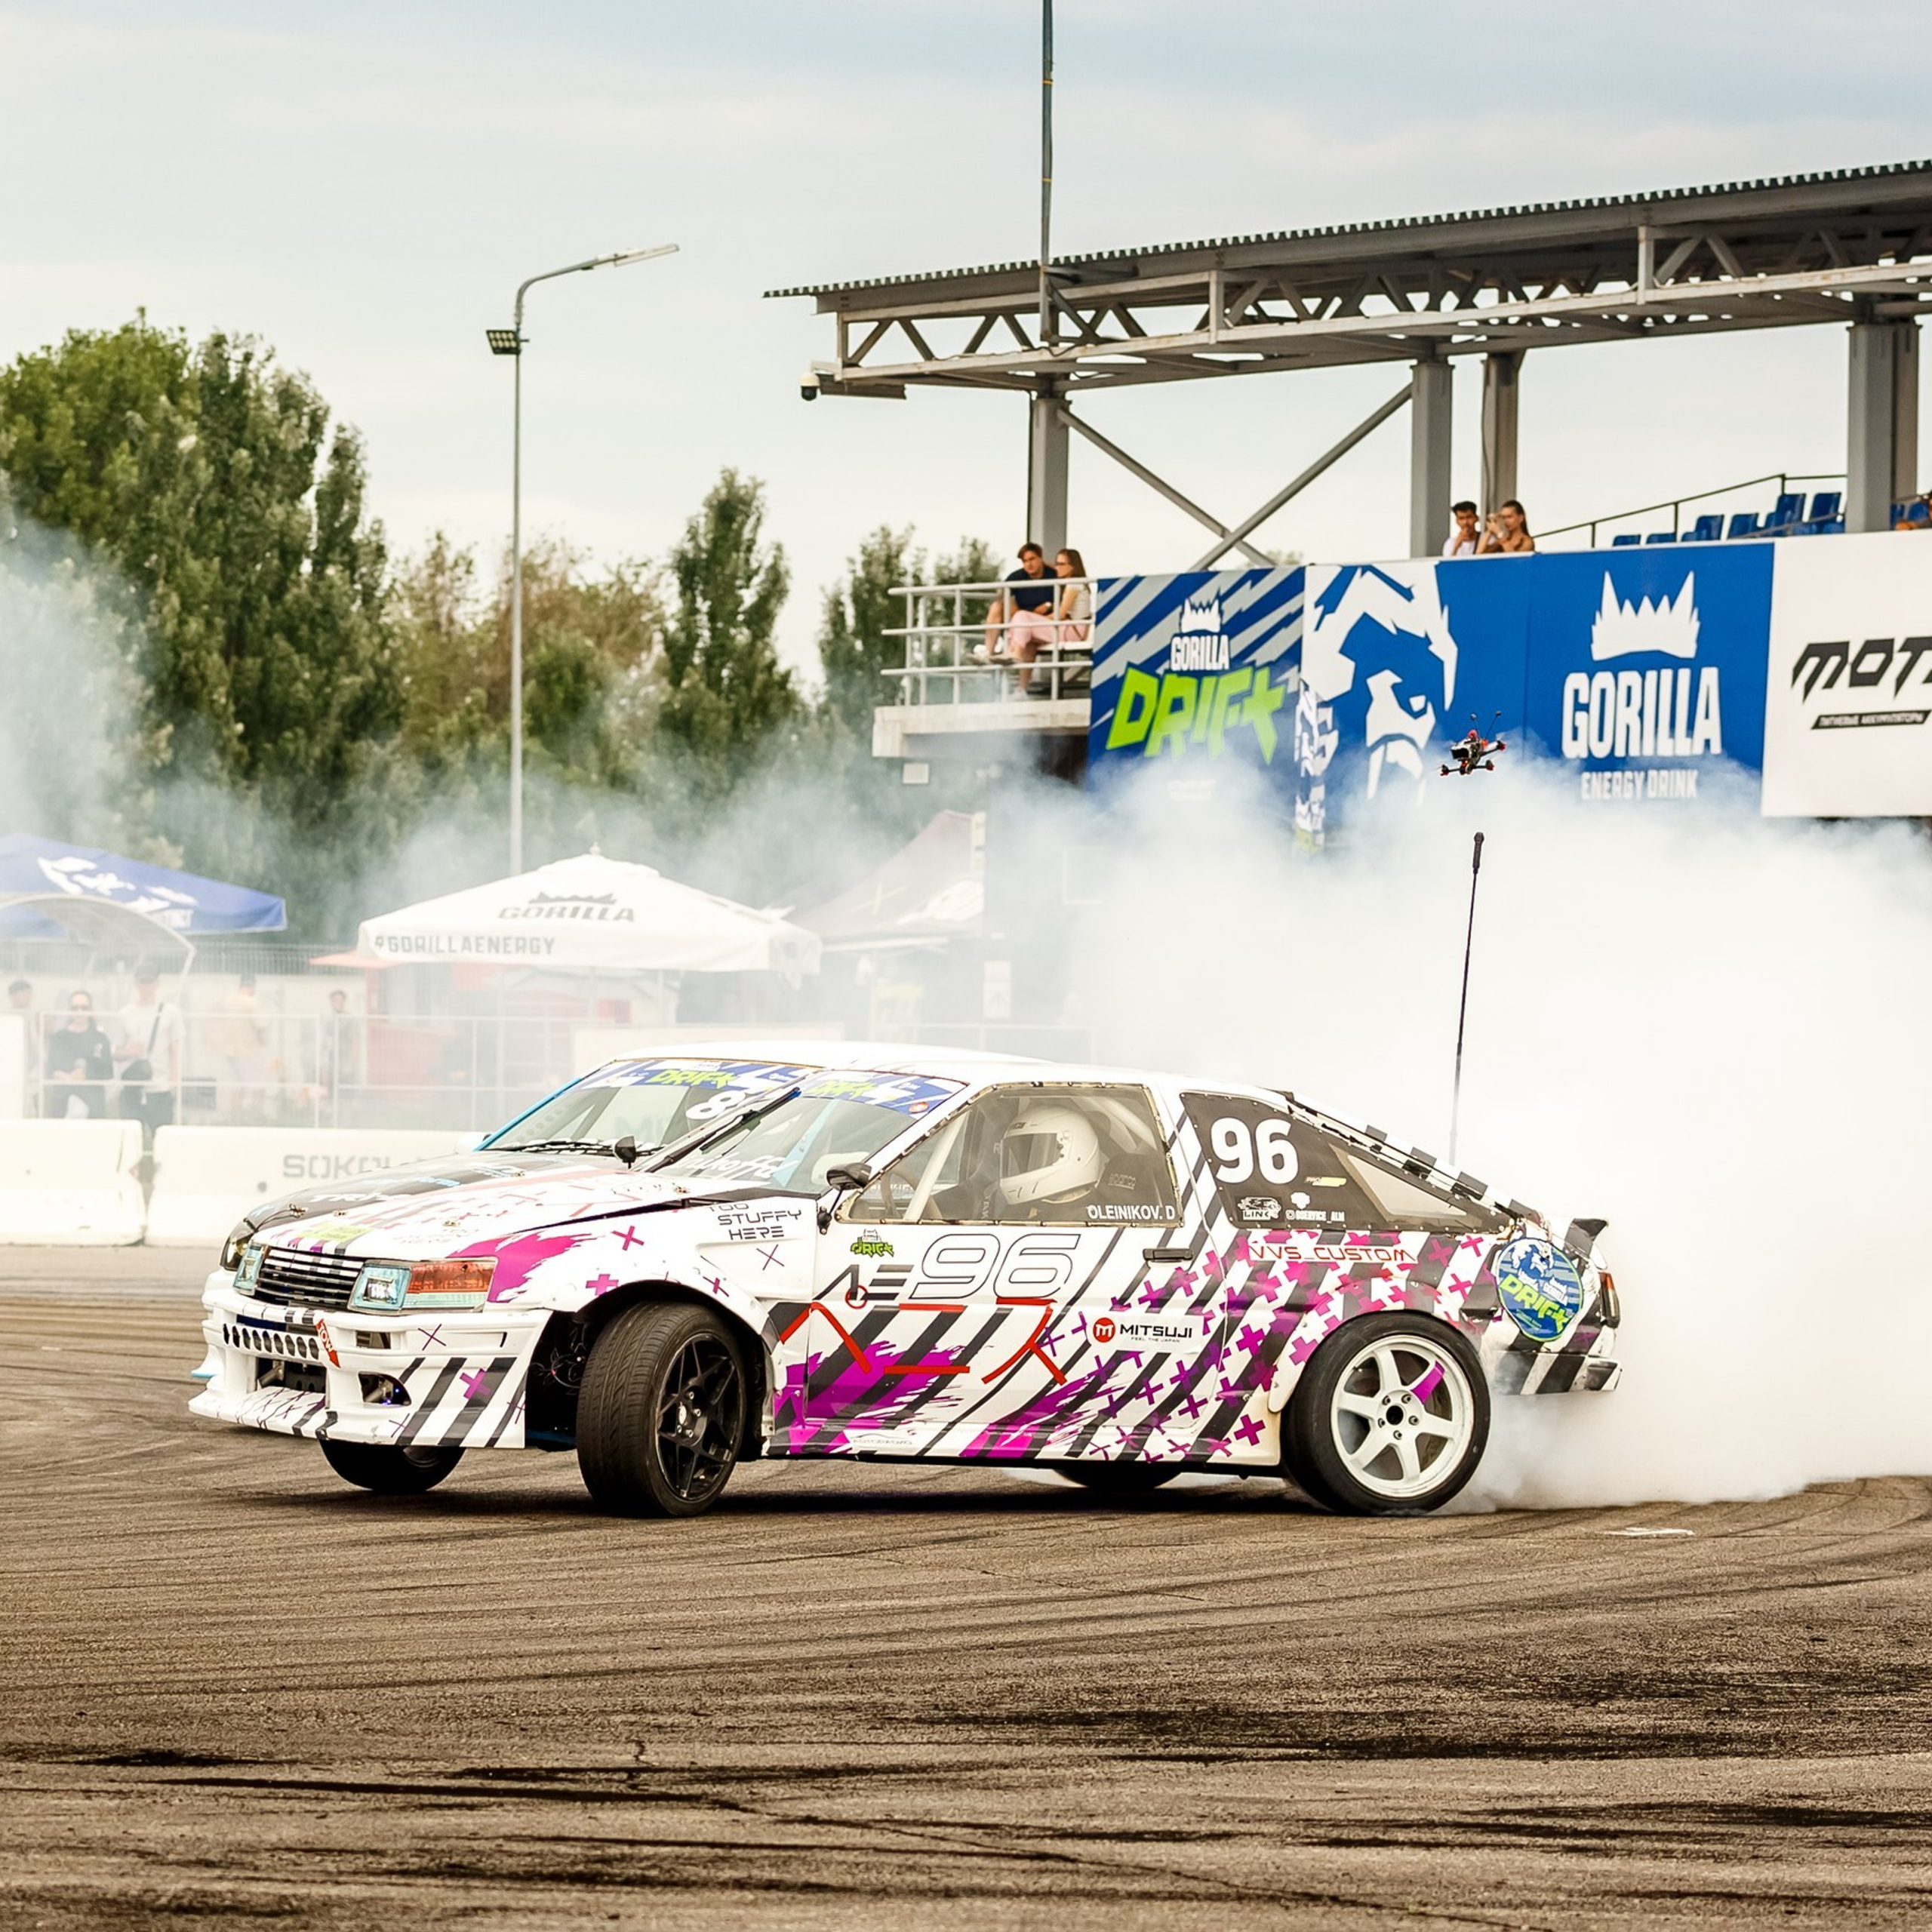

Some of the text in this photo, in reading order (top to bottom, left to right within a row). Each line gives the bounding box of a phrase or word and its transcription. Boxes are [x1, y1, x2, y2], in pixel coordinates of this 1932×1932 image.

[1171, 635, 1229, 671] GORILLA
[1106, 666, 1286, 766] DRIFT
[1562, 666, 1721, 758] GORILLA
[1581, 768, 1698, 800] ENERGY DRINK
[498, 906, 635, 922] GORILLA
[374, 936, 555, 955] #GORILLAENERGY
[1211, 1117, 1298, 1184] 96
[710, 1202, 749, 1212] TOO
[1088, 1204, 1176, 1220] OLEINIKOV. D
[718, 1209, 802, 1226] STUFFY
[728, 1226, 785, 1240] HERE
[1249, 1245, 1417, 1262] VVS_CUSTOM
[1499, 1273, 1571, 1334] DRIFT
[318, 1321, 334, 1352] TOW
[1119, 1324, 1192, 1339] MITSUJI
